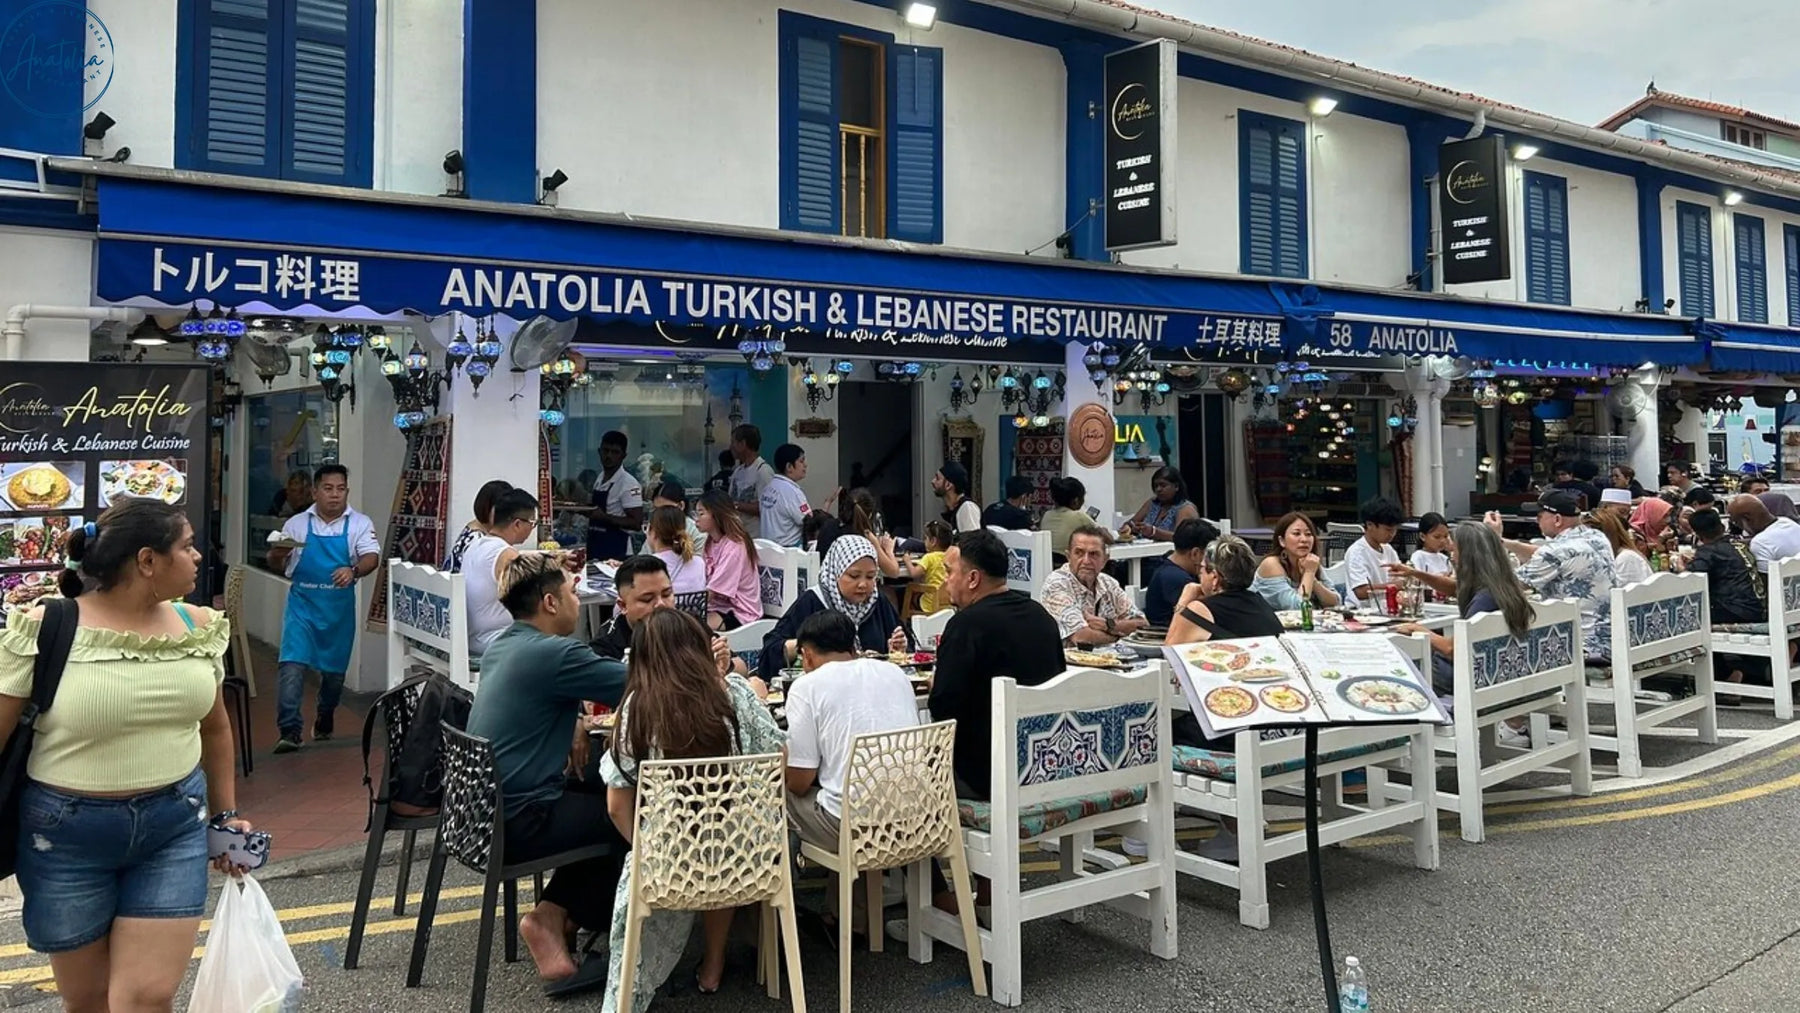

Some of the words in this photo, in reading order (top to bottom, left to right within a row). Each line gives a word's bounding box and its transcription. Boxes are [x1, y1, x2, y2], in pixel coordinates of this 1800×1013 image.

[1116, 154, 1152, 170] TURKISH
[1113, 182, 1155, 198] LEBANESE
[1117, 197, 1150, 211] CUISINE
[1452, 216, 1488, 228] TURKISH
[1450, 238, 1492, 250] LEBANESE
[1455, 250, 1488, 260] CUISINE
[153, 248, 361, 301] トルコ料理
[440, 268, 652, 315] ANATOLIA
[662, 281, 816, 323] TURKISH
[827, 292, 848, 325] &
[857, 294, 1004, 333] LEBANESE
[1012, 305, 1168, 341] RESTAURANT
[1196, 316, 1281, 347] 土耳其料理
[1330, 323, 1352, 347] 58
[1368, 326, 1459, 353] ANATOLIA
[63, 384, 192, 432] Anatolia
[0, 433, 49, 454] urkish
[51, 437, 69, 453] &
[72, 433, 138, 451] Lebanese
[141, 434, 190, 450] Cuisine
